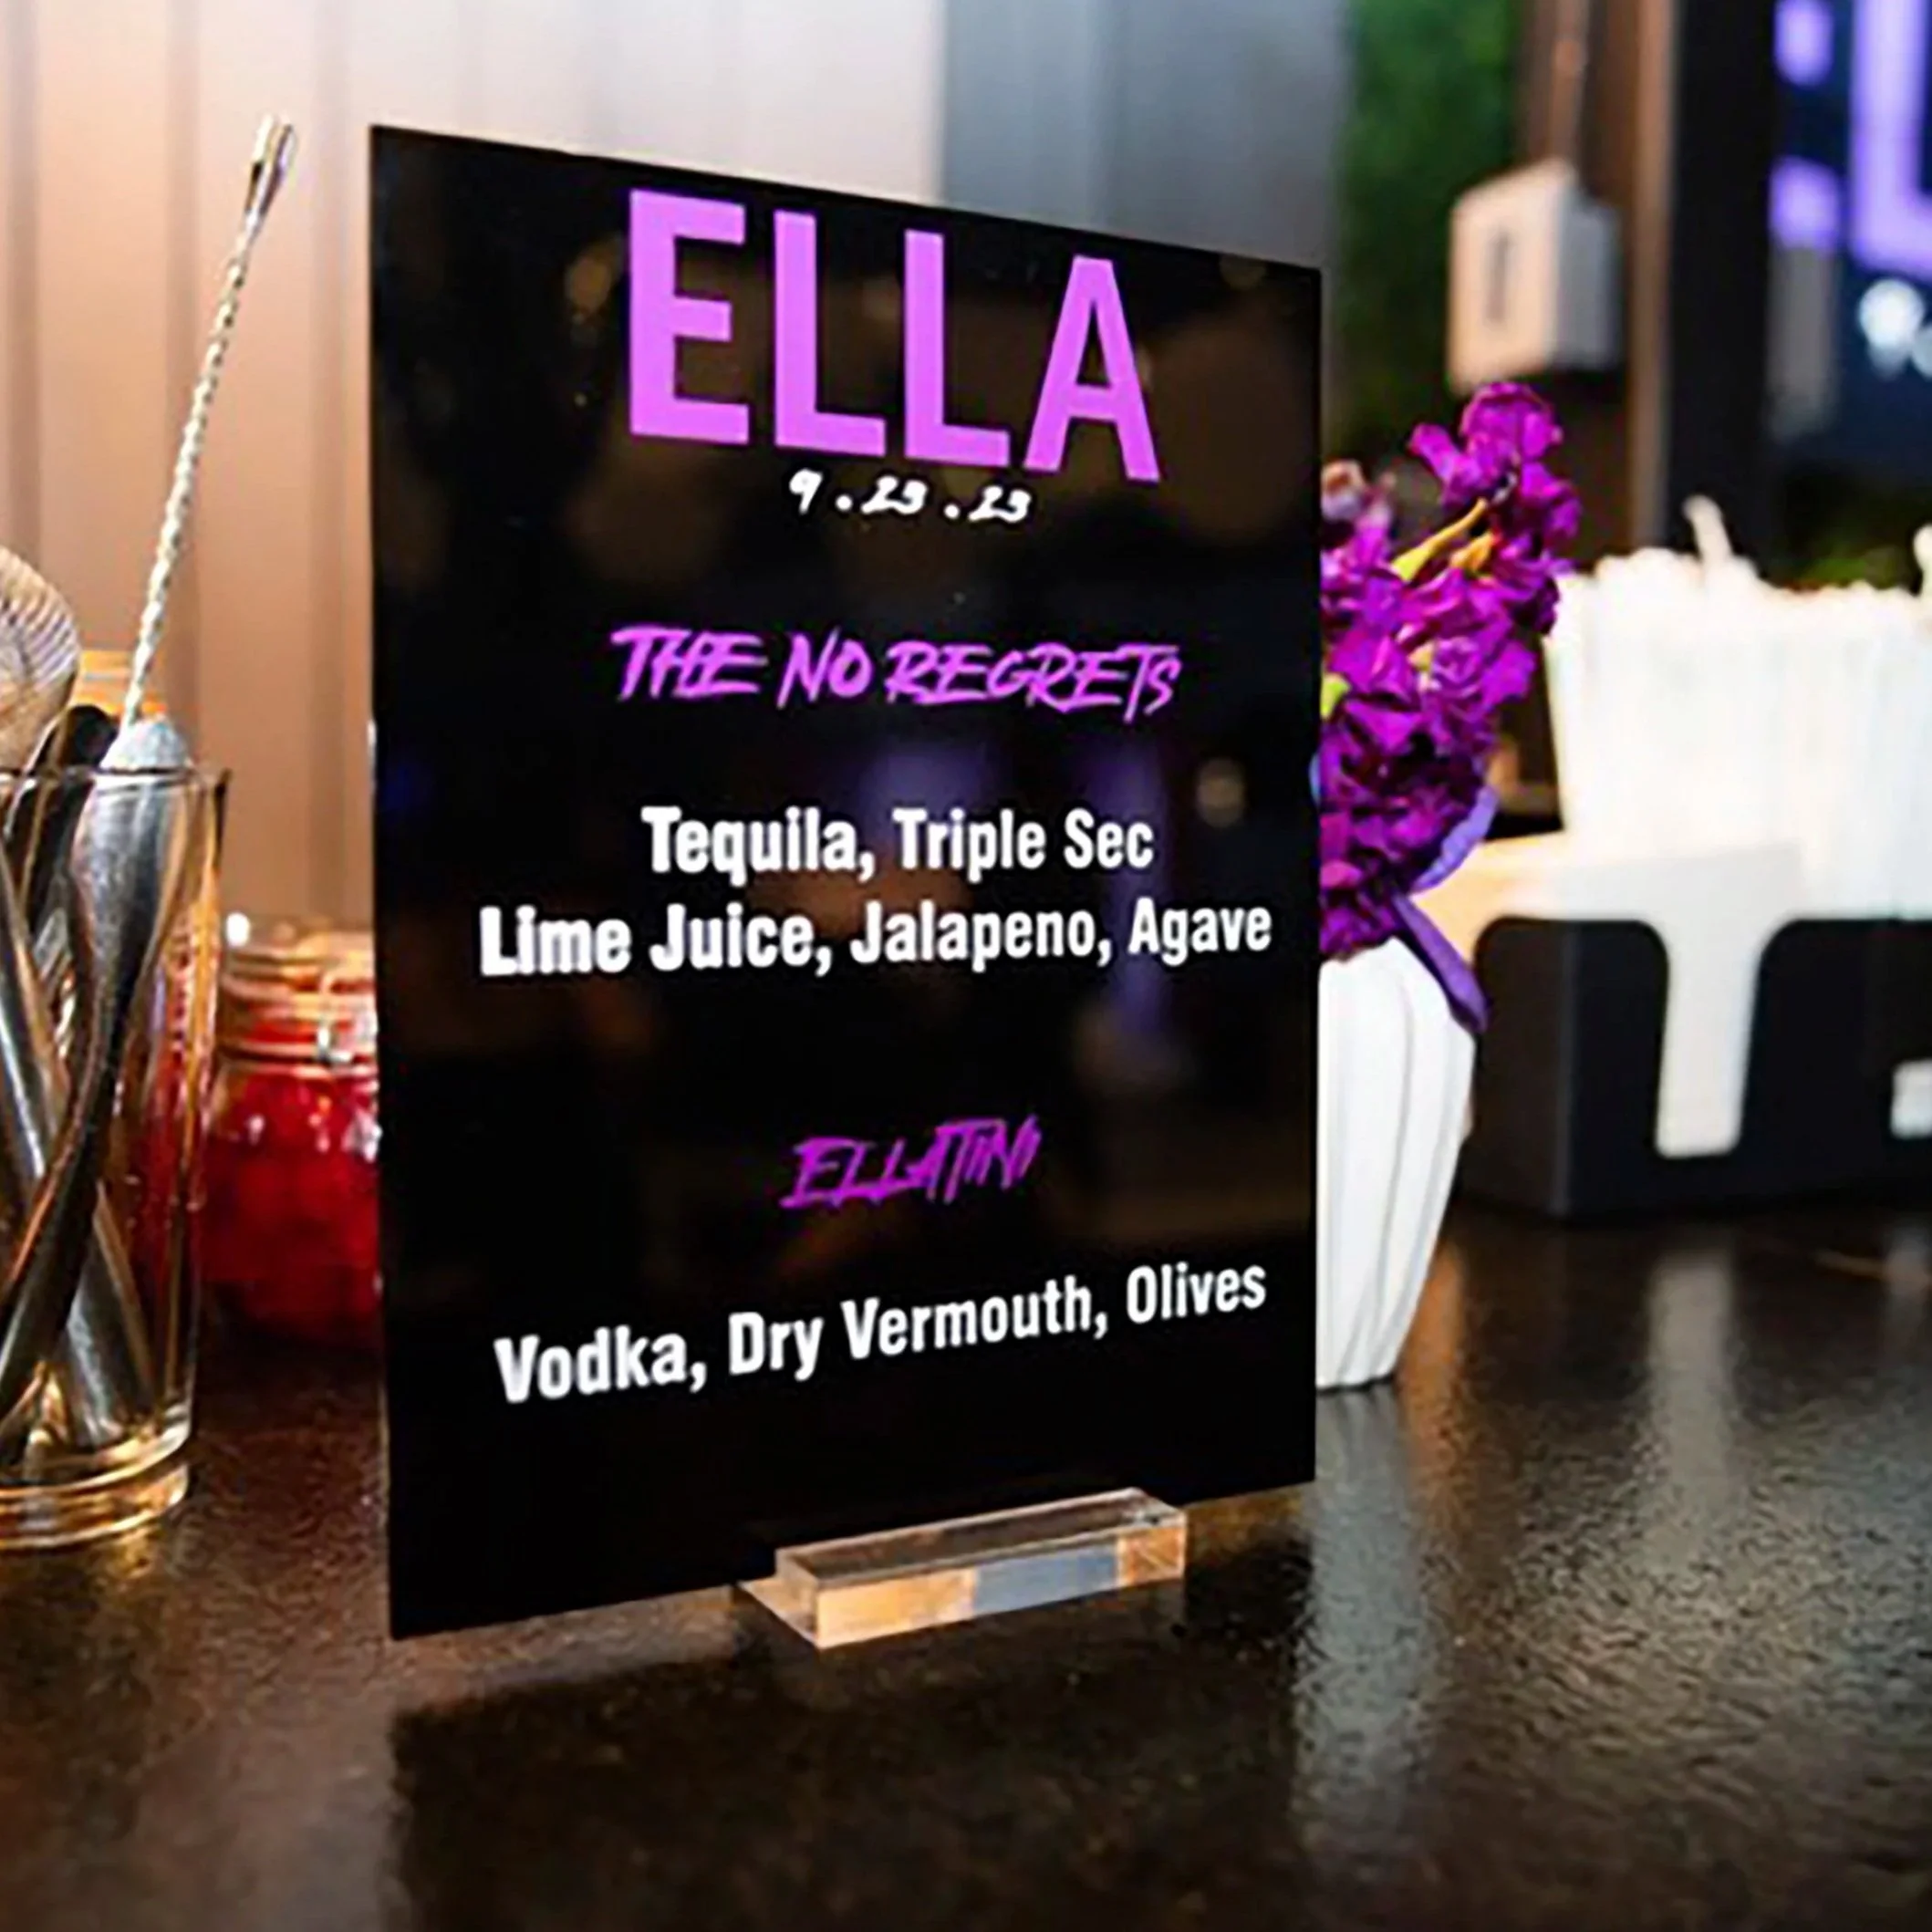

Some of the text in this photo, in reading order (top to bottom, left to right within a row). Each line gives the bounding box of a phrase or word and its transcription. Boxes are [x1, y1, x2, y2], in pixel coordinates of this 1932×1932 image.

[627, 188, 1162, 483] ELLA
[610, 625, 1182, 722] THE NO REGRETS
[640, 805, 1154, 888] Tequila, Triple Sec
[480, 896, 1272, 977] Lime Juice, Jalapeno, Agave
[779, 1114, 1042, 1209] ELLATINI
[493, 1262, 1266, 1403] Vodka, Dry Vermouth, Olives
